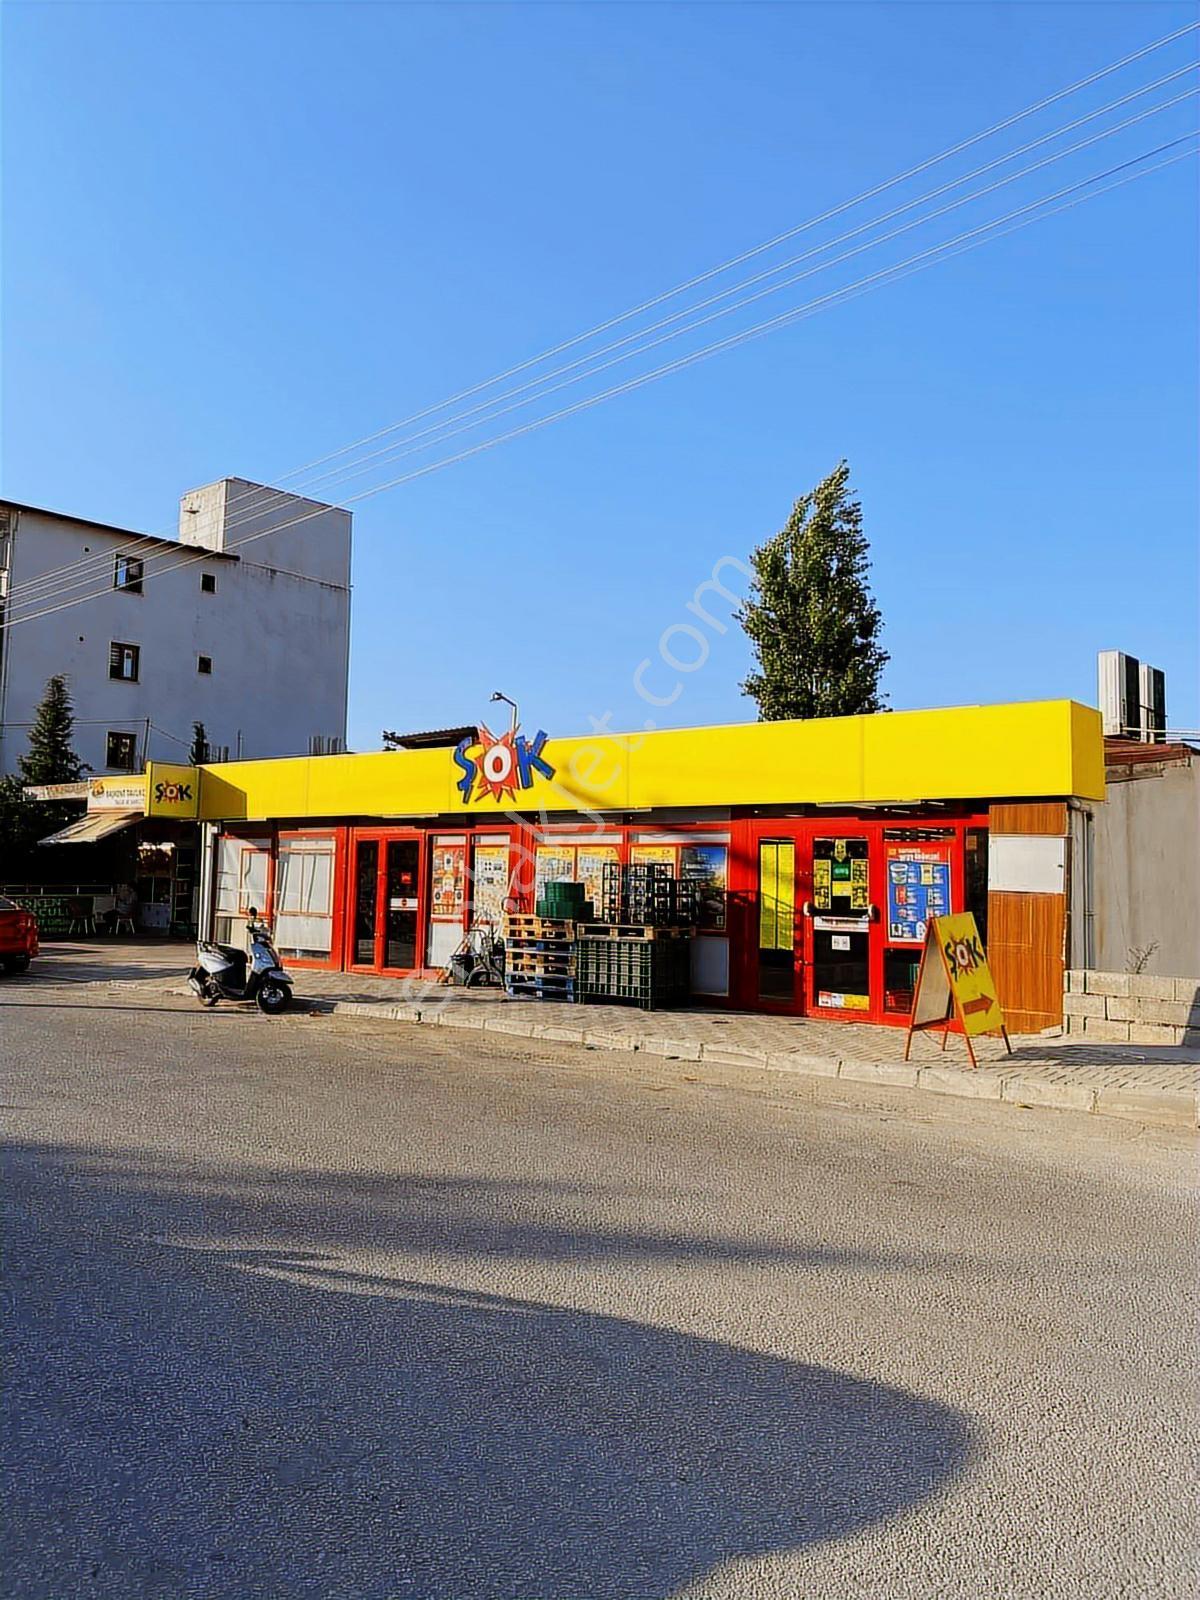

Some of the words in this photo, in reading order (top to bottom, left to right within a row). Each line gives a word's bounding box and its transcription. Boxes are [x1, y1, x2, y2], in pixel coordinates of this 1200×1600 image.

[453, 730, 556, 804] ŞOK
[155, 783, 193, 803] ŞOK
[945, 936, 985, 983] ŞOK
